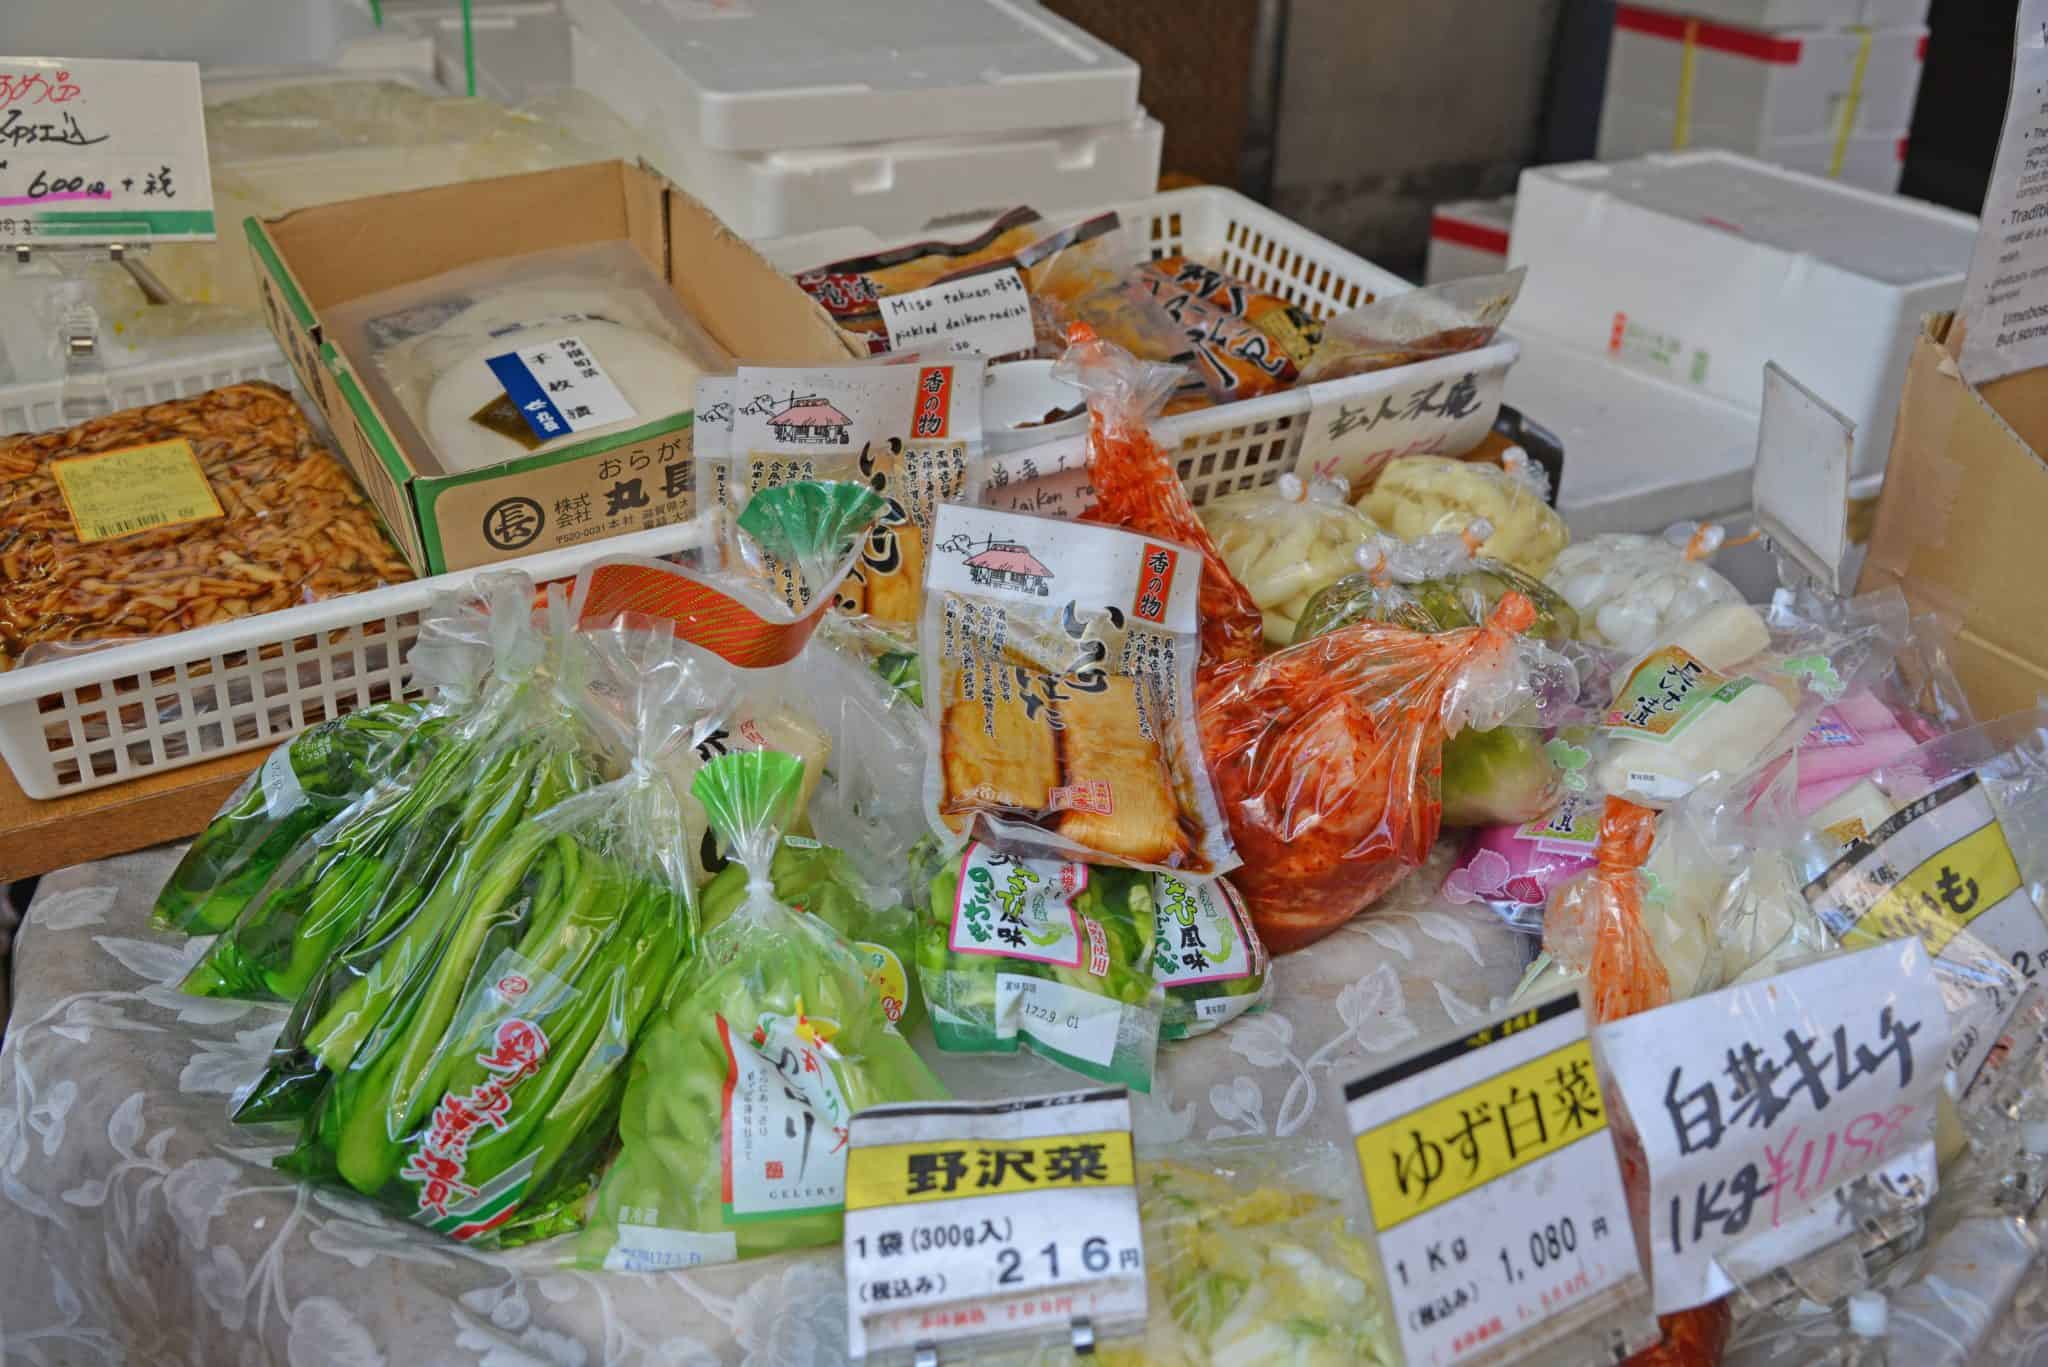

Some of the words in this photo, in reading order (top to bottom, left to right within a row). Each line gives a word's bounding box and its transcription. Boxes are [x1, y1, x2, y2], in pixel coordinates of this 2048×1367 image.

[917, 370, 946, 435] 香の物
[604, 460, 695, 516] 丸長
[1138, 550, 1170, 617] 香の物
[1664, 1004, 1923, 1158] 白菜キムチ
[1391, 1058, 1600, 1205] ゆず白菜
[906, 1143, 1108, 1196] 野沢菜
